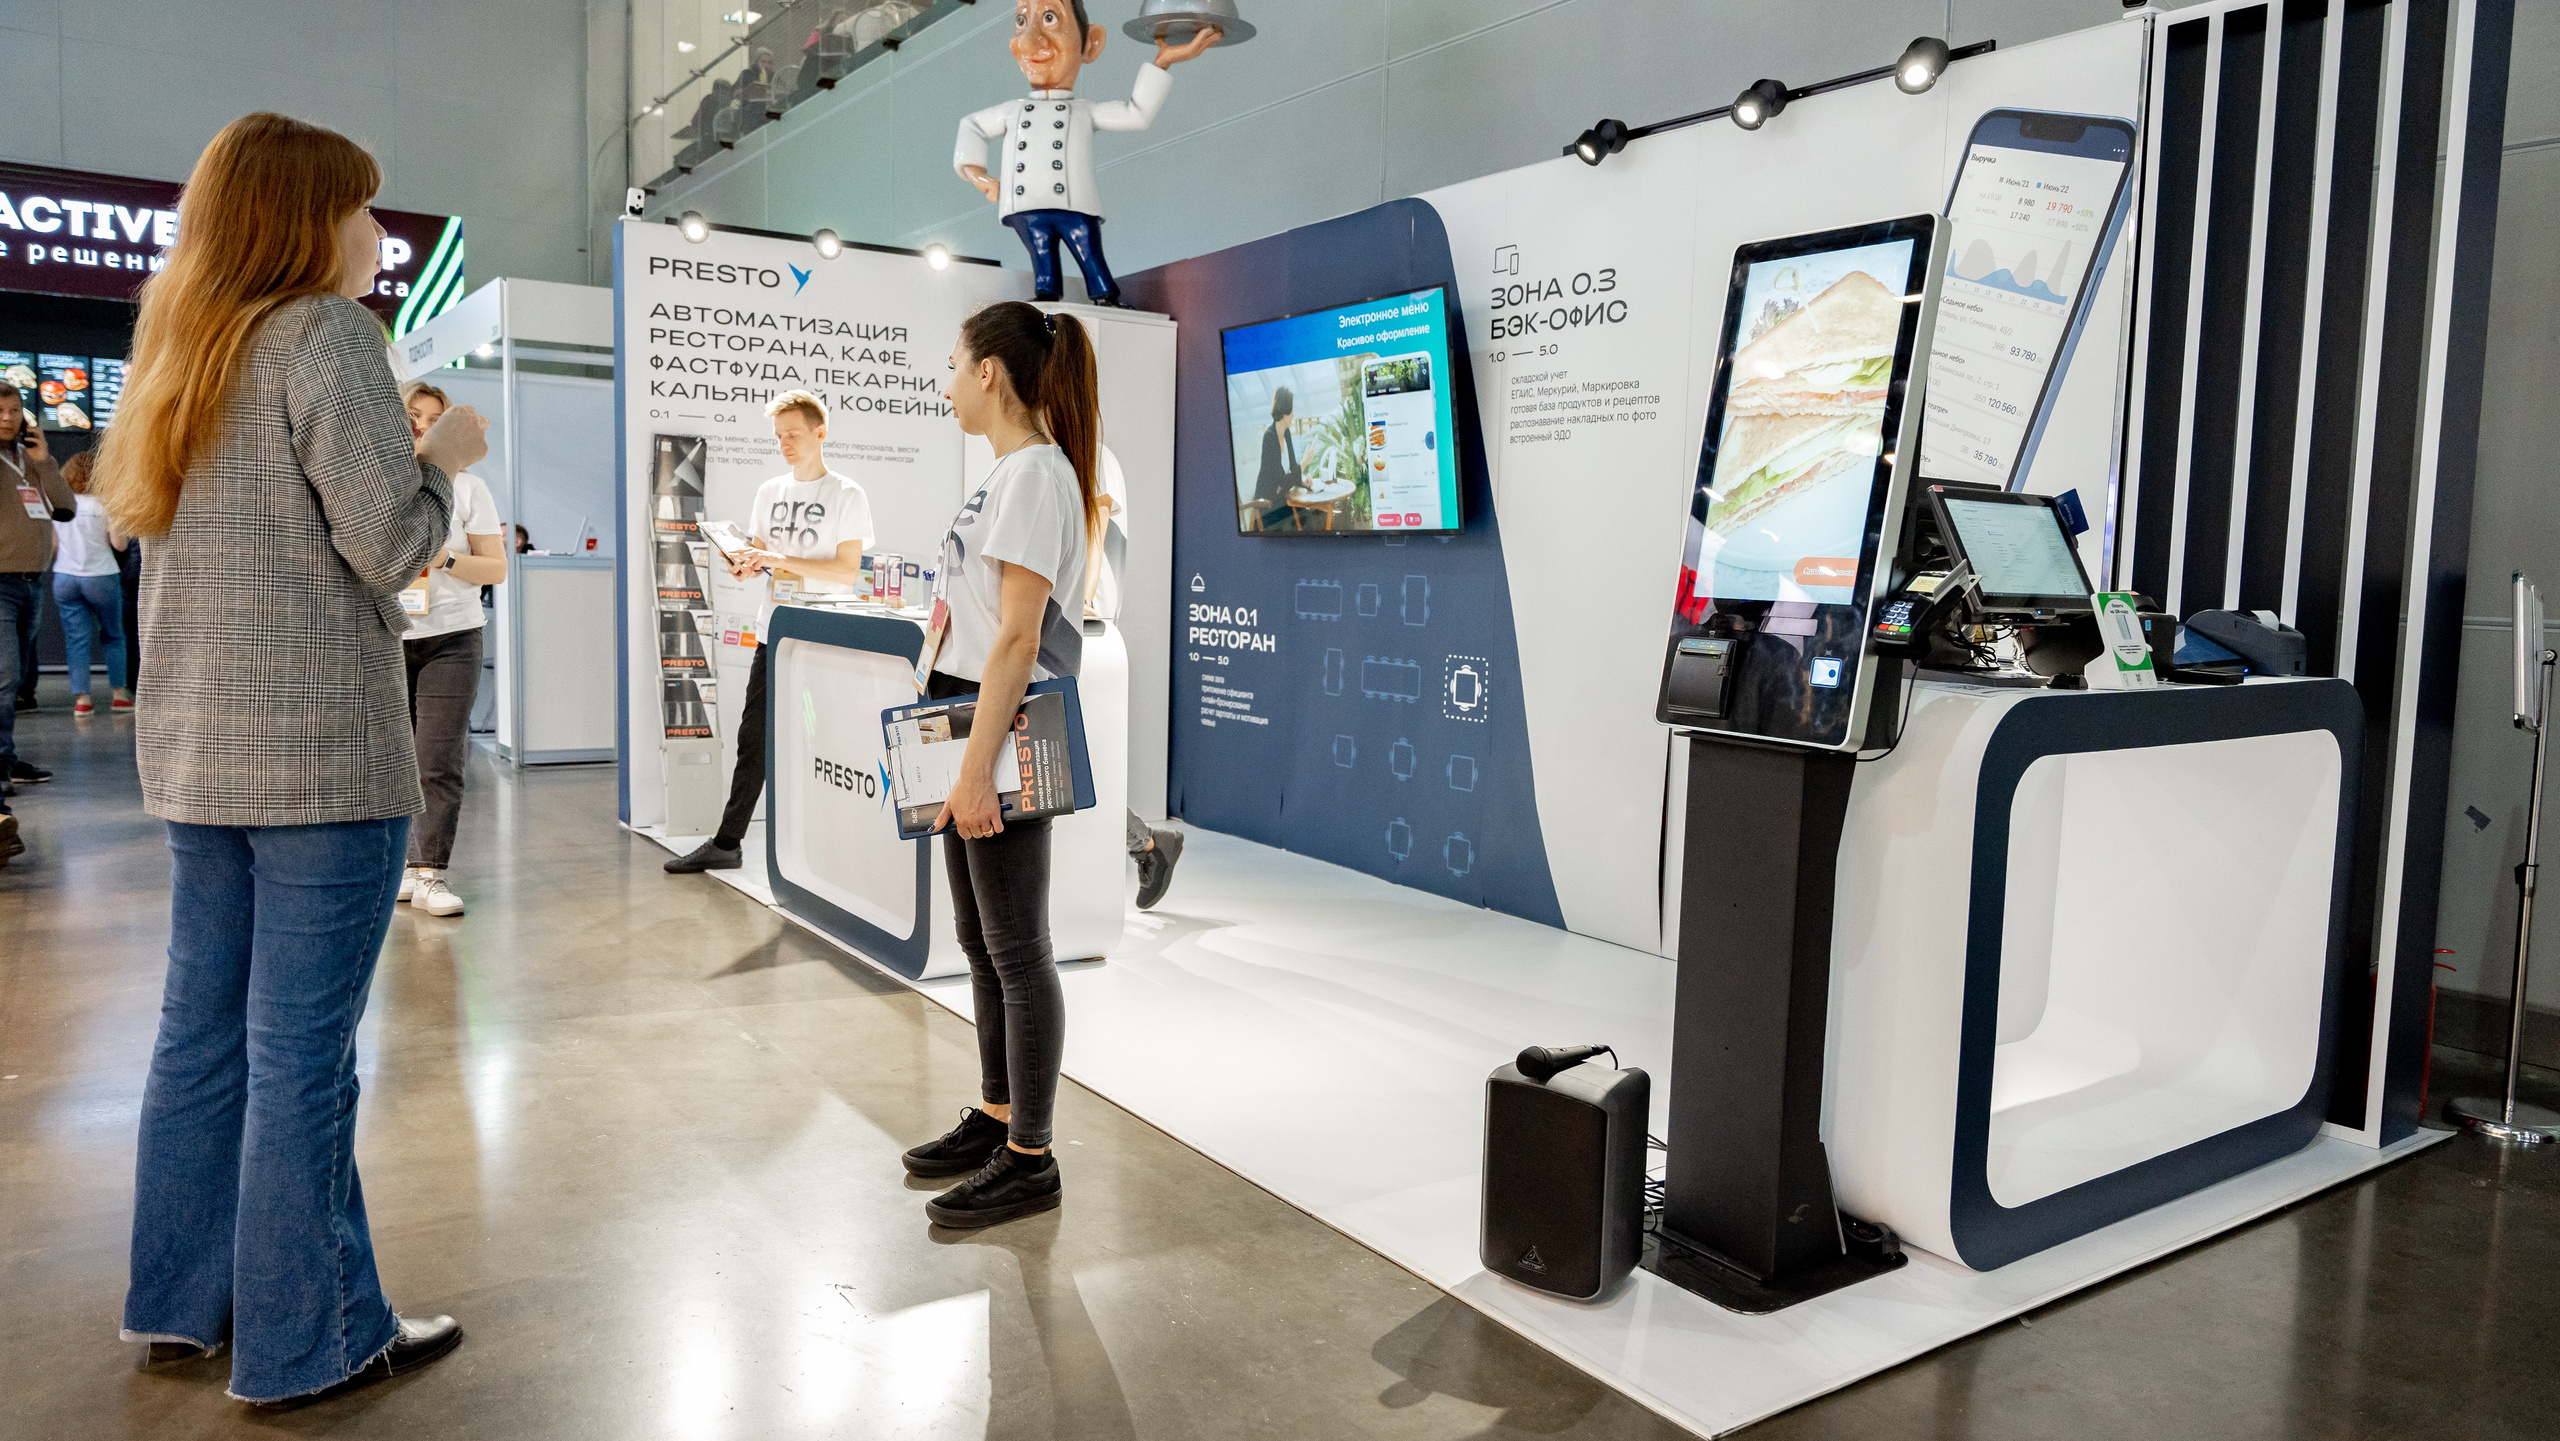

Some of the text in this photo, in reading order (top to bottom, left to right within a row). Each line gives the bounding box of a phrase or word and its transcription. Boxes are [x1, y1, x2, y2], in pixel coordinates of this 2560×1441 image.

[1971, 153, 1996, 164] Выручка
[2005, 178, 2021, 187] Июнь
[2043, 183, 2060, 192] Июнь
[27, 242, 166, 273] решени
[649, 256, 781, 288] PRESTO
[1490, 277, 1563, 309] ЗОНА
[649, 303, 908, 343] АВТОМАТИЗАЦИЯ
[1338, 302, 1429, 328] Электронное меню
[1490, 299, 1628, 340] БЭК-ОФИС
[1336, 324, 1430, 350] Красивое оформление
[649, 328, 912, 370] РЕСТОРАНА, КАФЕ,
[1489, 351, 1505, 363] 1.0
[1539, 343, 1558, 357] 5.0
[1931, 349, 1949, 359] дьмое
[2009, 346, 2021, 357] 93
[649, 354, 941, 397] ФАСТФУДА, ПЕКАРНИ,
[1511, 370, 1568, 385] складской учет
[650, 381, 833, 412] КАЛЬЯНЙ,
[1511, 379, 1640, 400] ЕГАИС, Меркурий, Маркировка
[1510, 403, 1537, 415] готовая
[1539, 400, 1556, 411] база
[1558, 398, 1602, 410] продуктов
[1612, 394, 1660, 408] рецептов
[1988, 398, 2001, 409] 120
[2001, 402, 2017, 414] 560
[649, 409, 670, 419] 0.1
[714, 413, 737, 423] 0.4
[1509, 410, 1657, 431] распознавание накладных по фото
[1509, 429, 1571, 446] встроенный ЭДО
[1973, 450, 1984, 461] 35
[770, 501, 826, 526] pre
[769, 521, 819, 550] sto
[1803, 566, 1832, 577] Сдел
[658, 590, 702, 599] PRESTO
[1189, 603, 1257, 627] ЗОНА 0.1
[1189, 627, 1275, 653] РЕСТОРАН
[662, 659, 705, 667] PRESTO
[666, 728, 710, 736] PRESTO
[1015, 713, 1037, 812] PRESTO
[1034, 740, 1043, 787] автоматизация
[814, 757, 876, 799] PRESTO
[1044, 765, 1054, 809] ресторанного
[910, 807, 918, 824] sab
